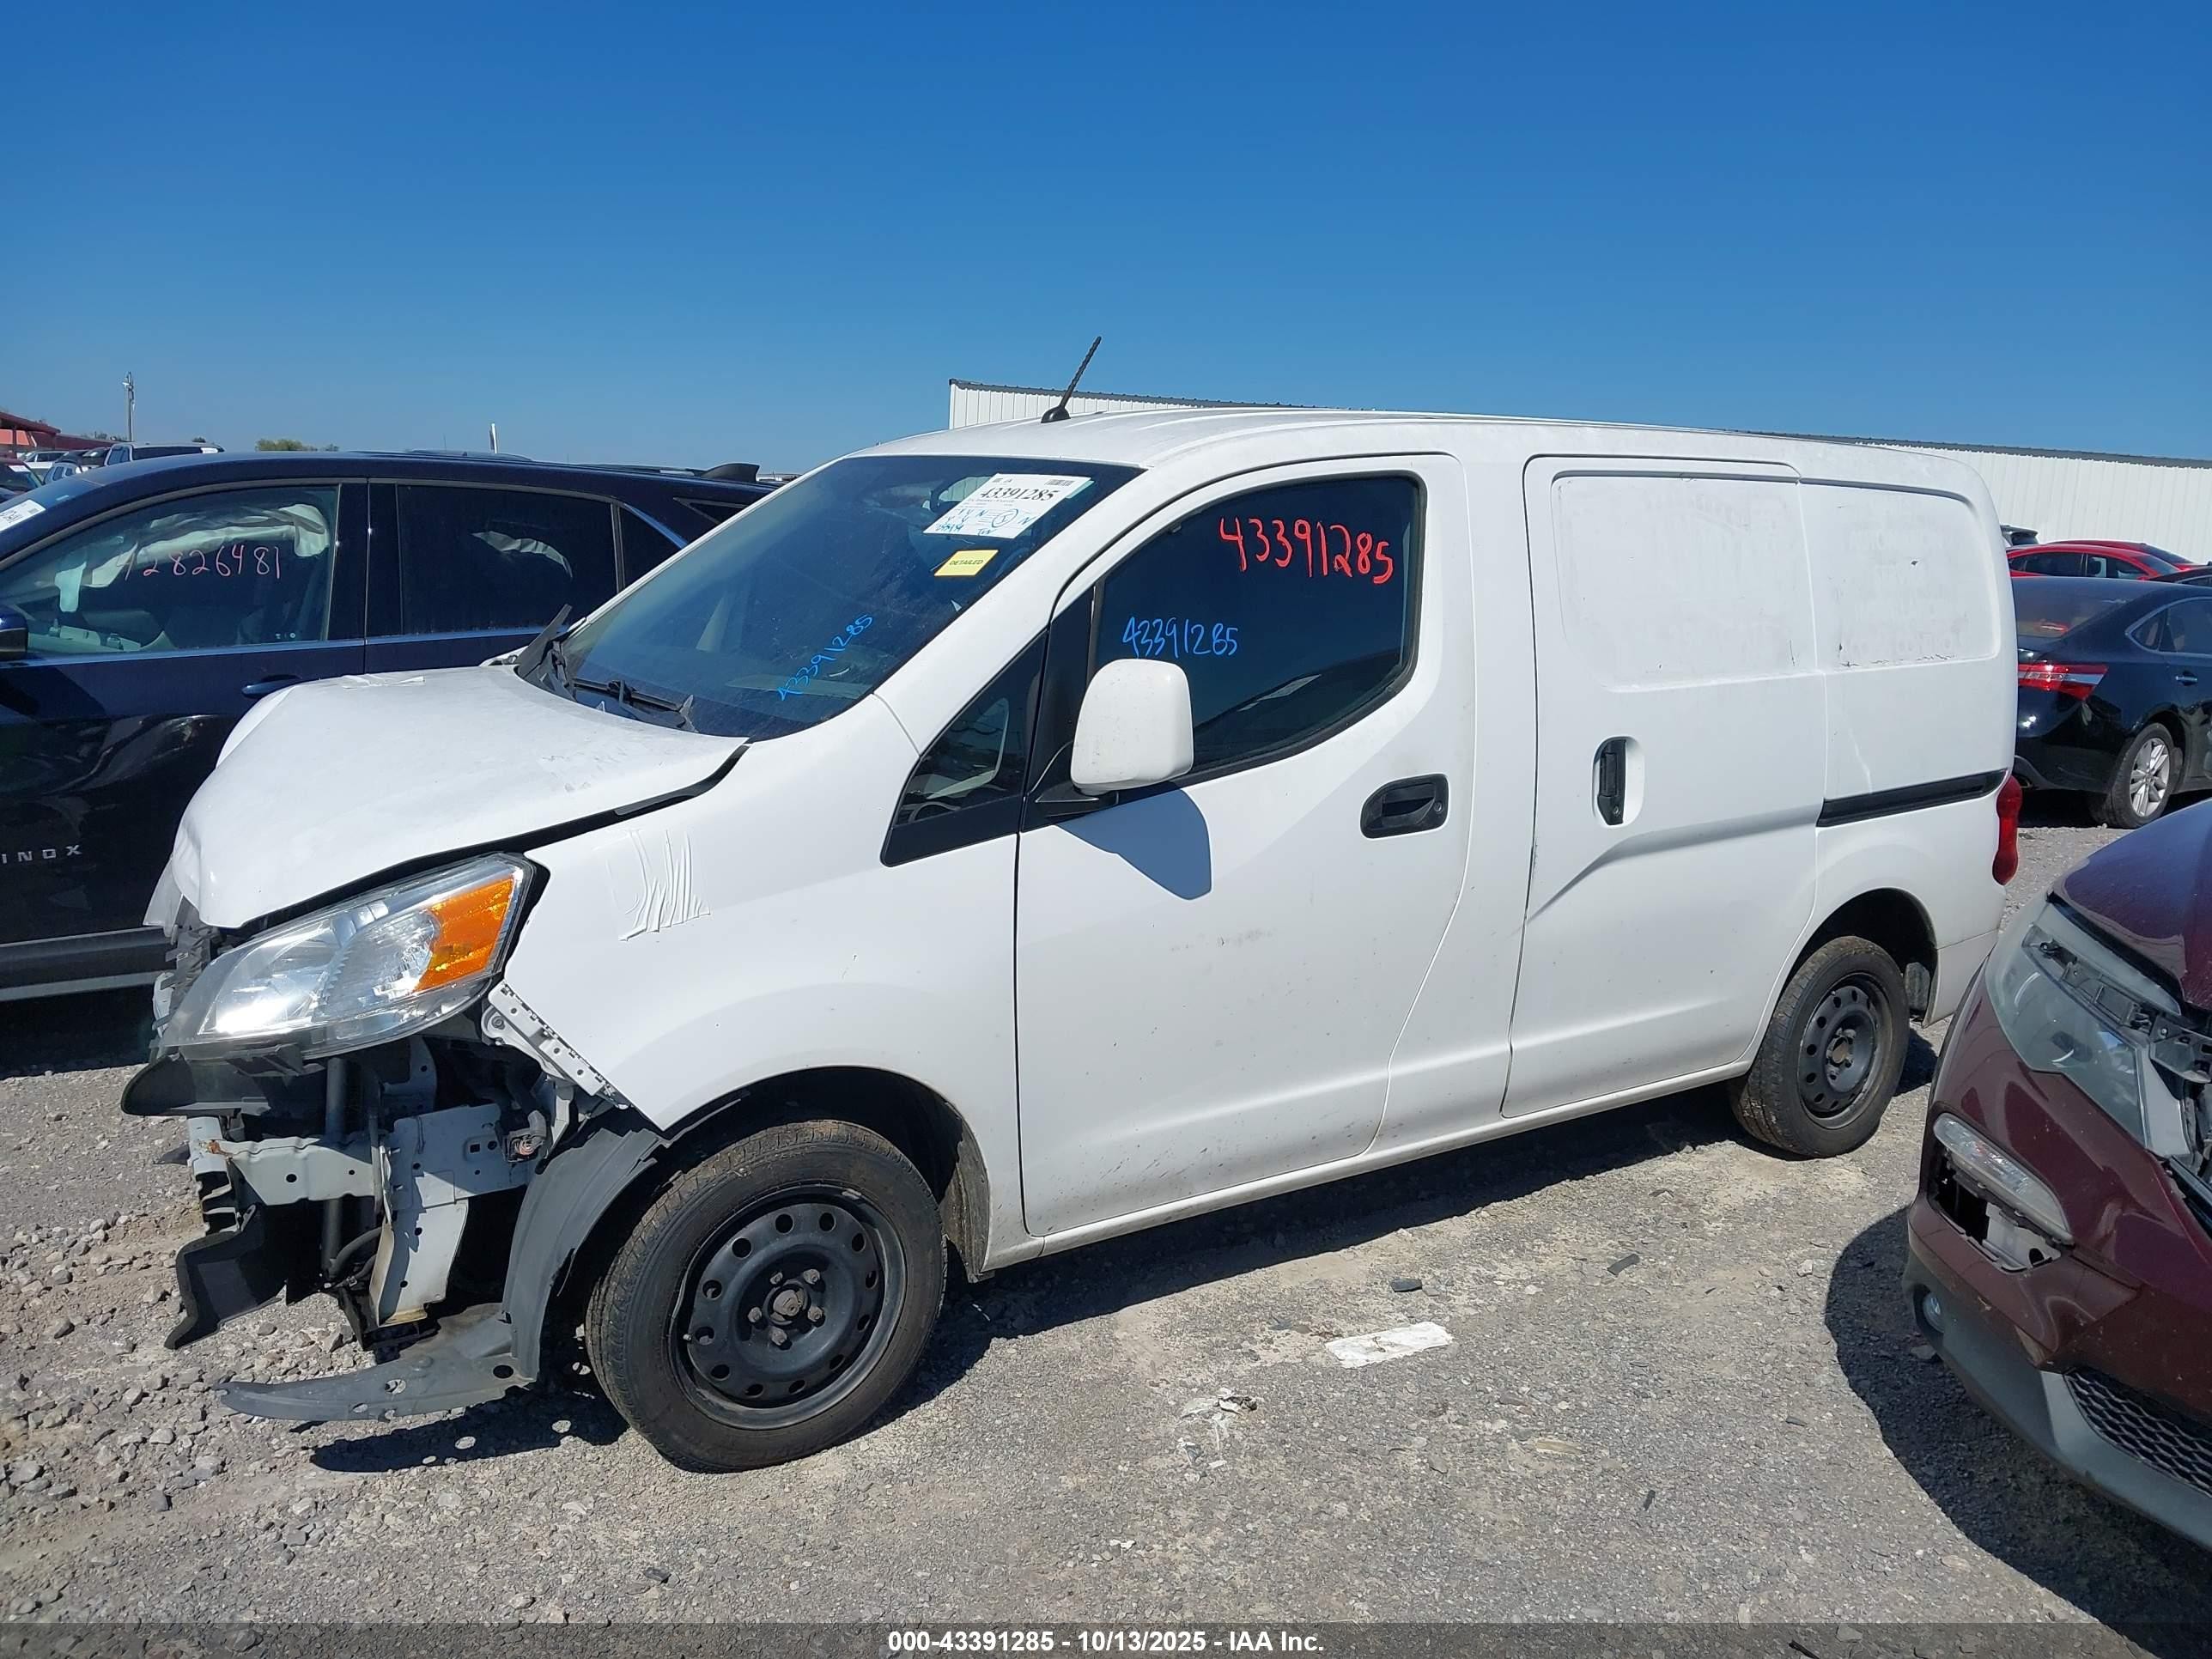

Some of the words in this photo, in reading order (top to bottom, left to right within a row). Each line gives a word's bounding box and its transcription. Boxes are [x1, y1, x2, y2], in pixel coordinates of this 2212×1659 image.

[981, 487, 1060, 501] 43391285
[1219, 517, 1394, 584] 43391285
[776, 614, 873, 702] 43391285
[1122, 617, 1239, 659] 43391285
